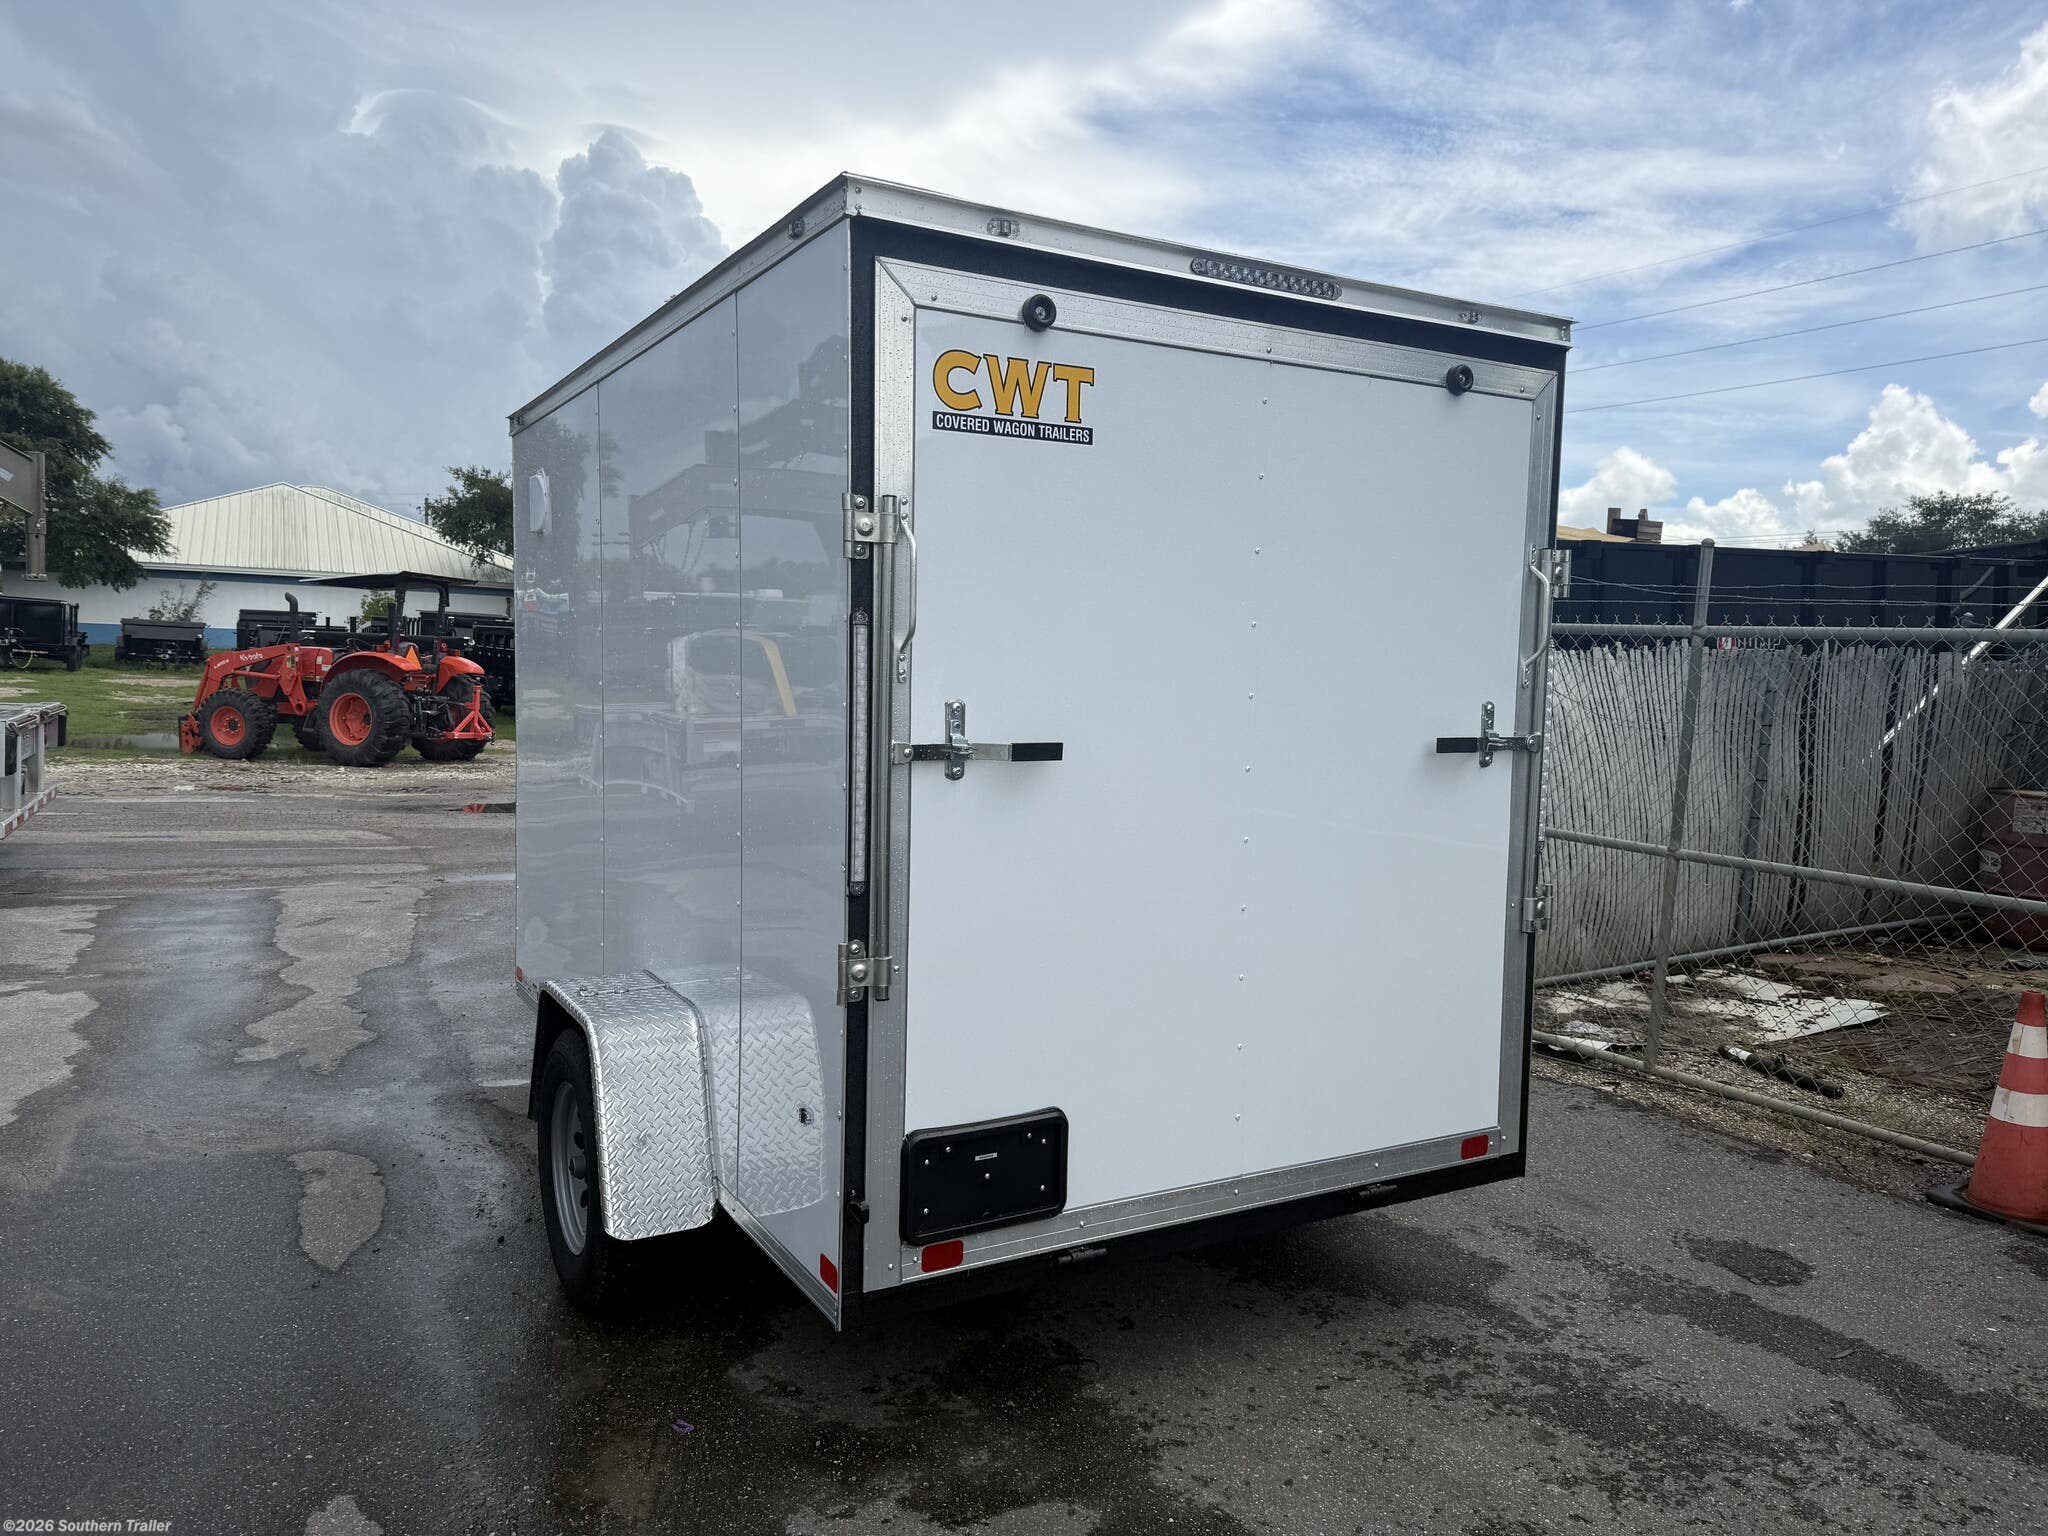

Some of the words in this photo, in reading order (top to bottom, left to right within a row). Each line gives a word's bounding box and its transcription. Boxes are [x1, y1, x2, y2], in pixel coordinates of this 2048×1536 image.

[932, 349, 1095, 423] CWT
[936, 414, 990, 432] COVERED
[993, 420, 1035, 437] WAGON
[1038, 425, 1090, 443] TRAILERS
